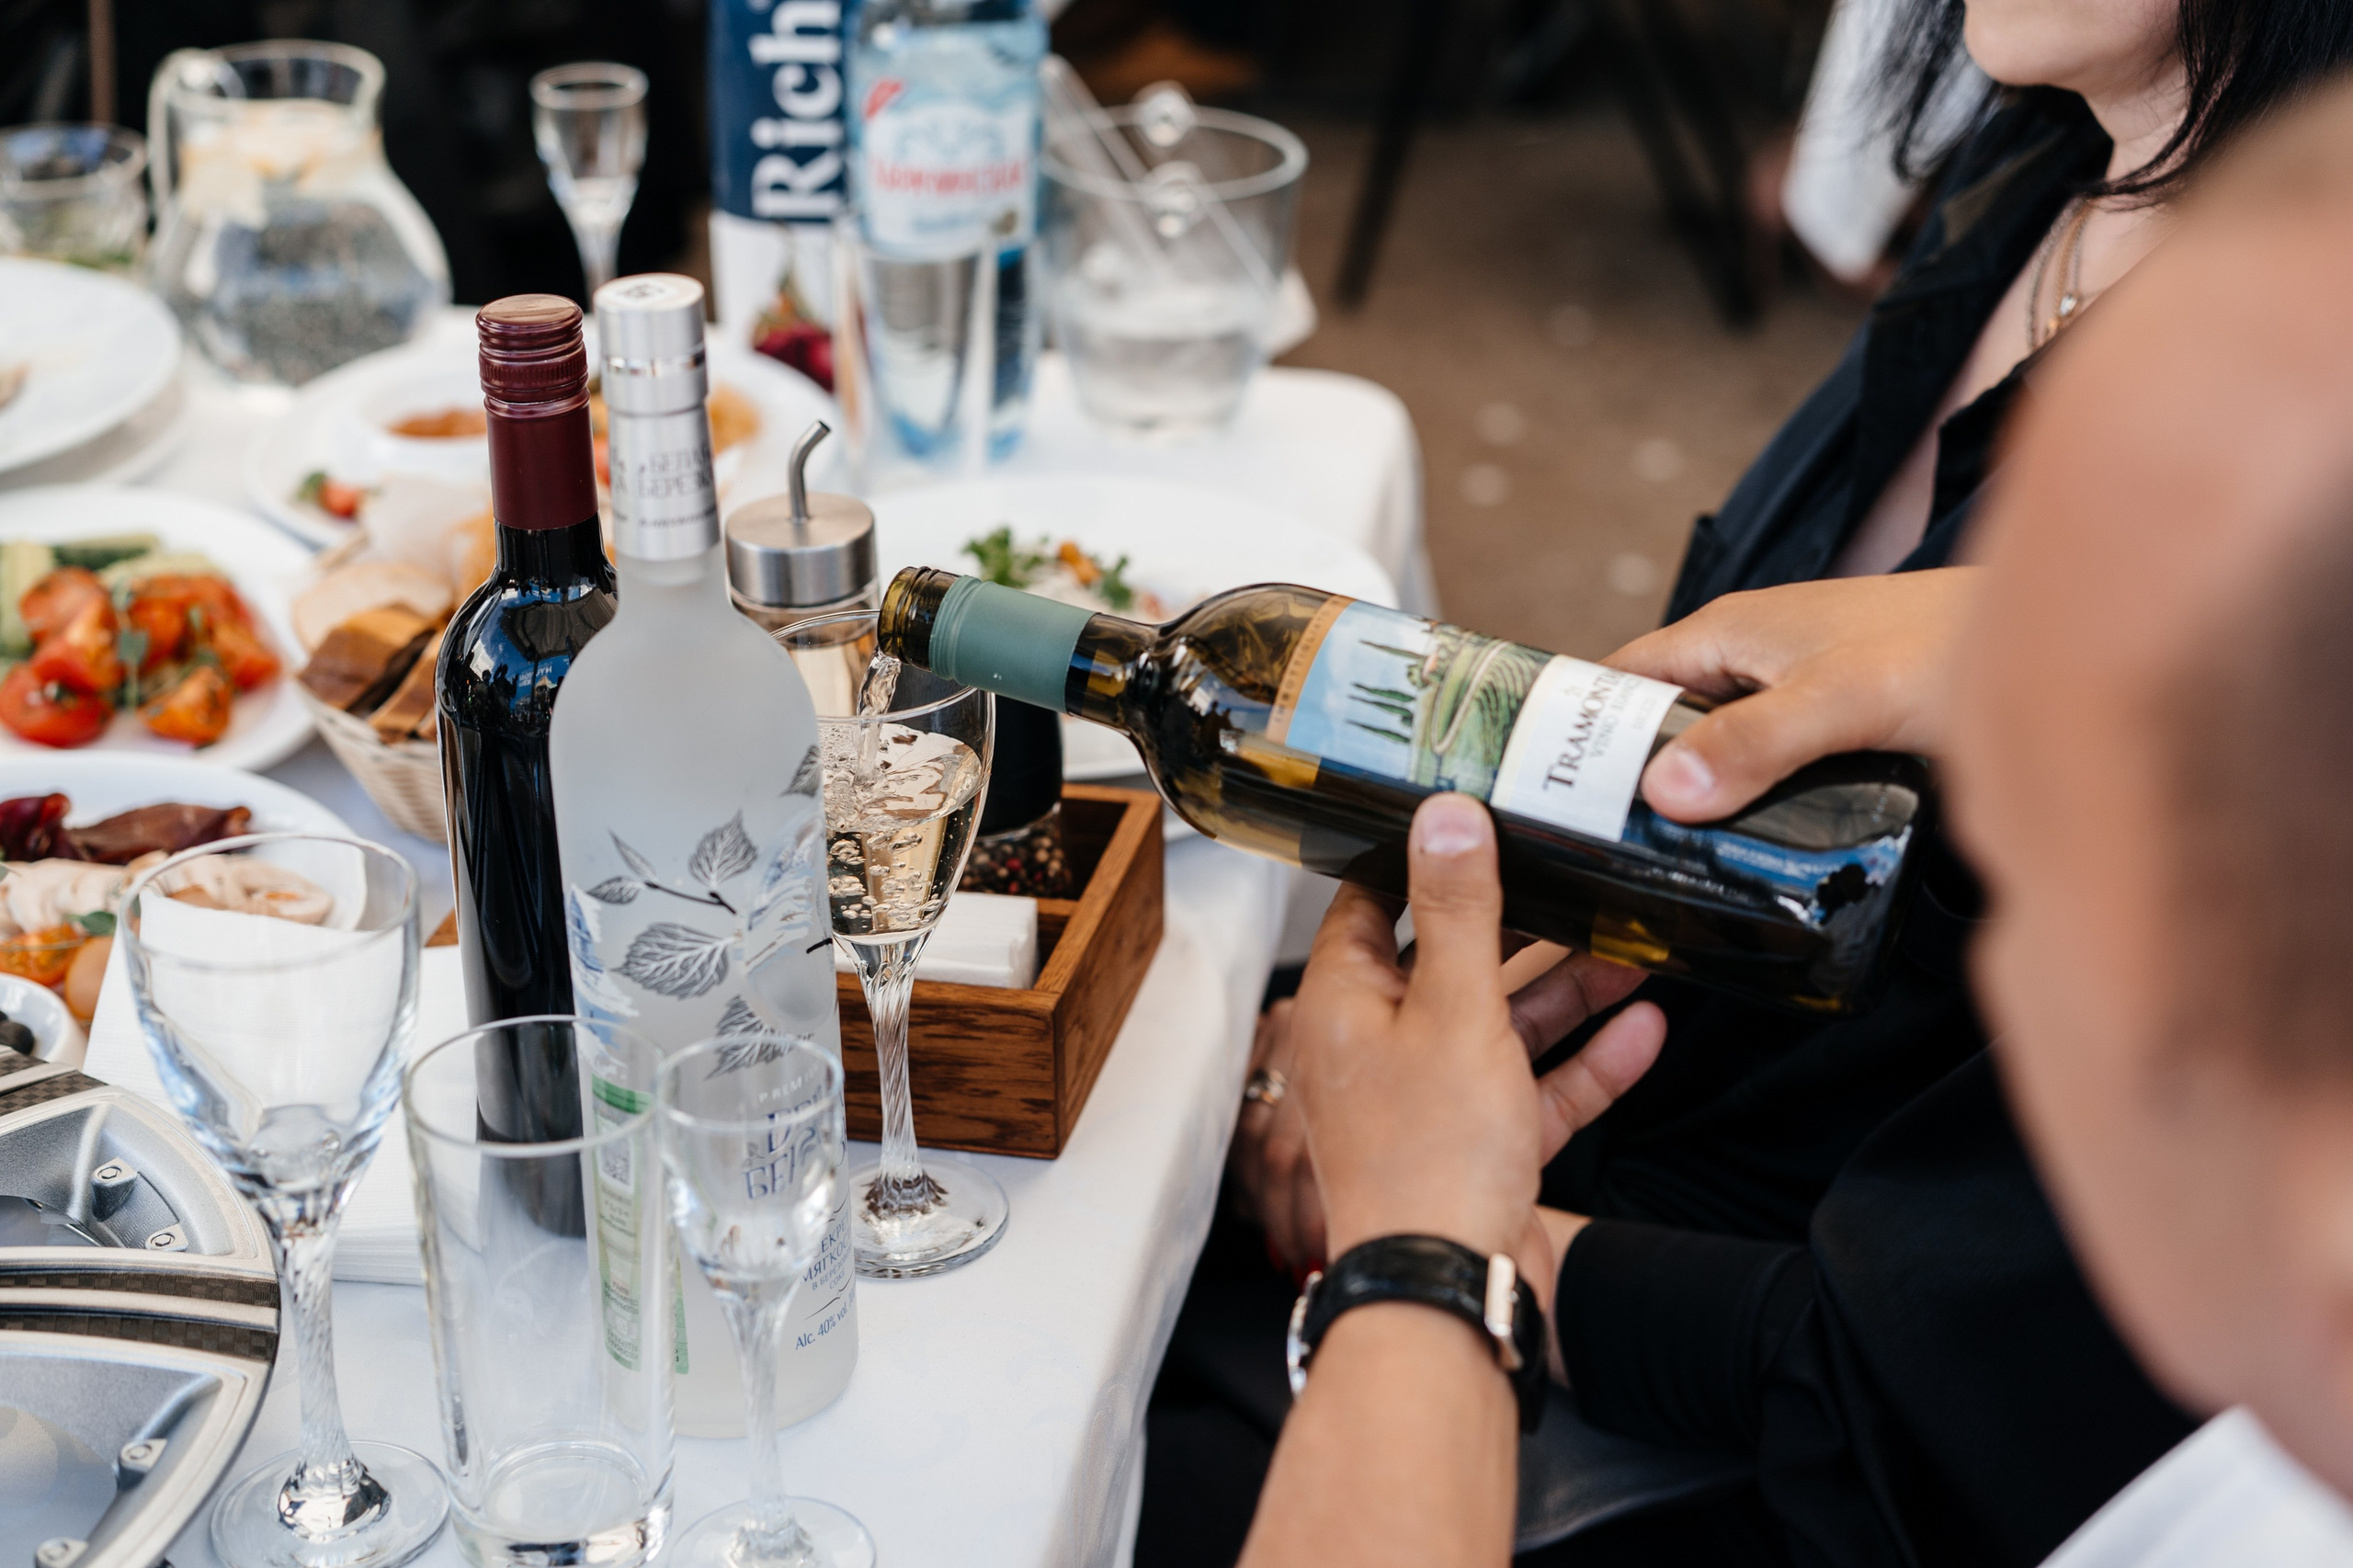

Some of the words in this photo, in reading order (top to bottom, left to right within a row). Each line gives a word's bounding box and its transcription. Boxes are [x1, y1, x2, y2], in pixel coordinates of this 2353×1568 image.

[749, 0, 844, 220] Rich
[812, 1281, 818, 1291] В
[829, 1267, 846, 1290] СОКЕ
[795, 1333, 816, 1350] Alc.
[817, 1313, 836, 1336] 40%
